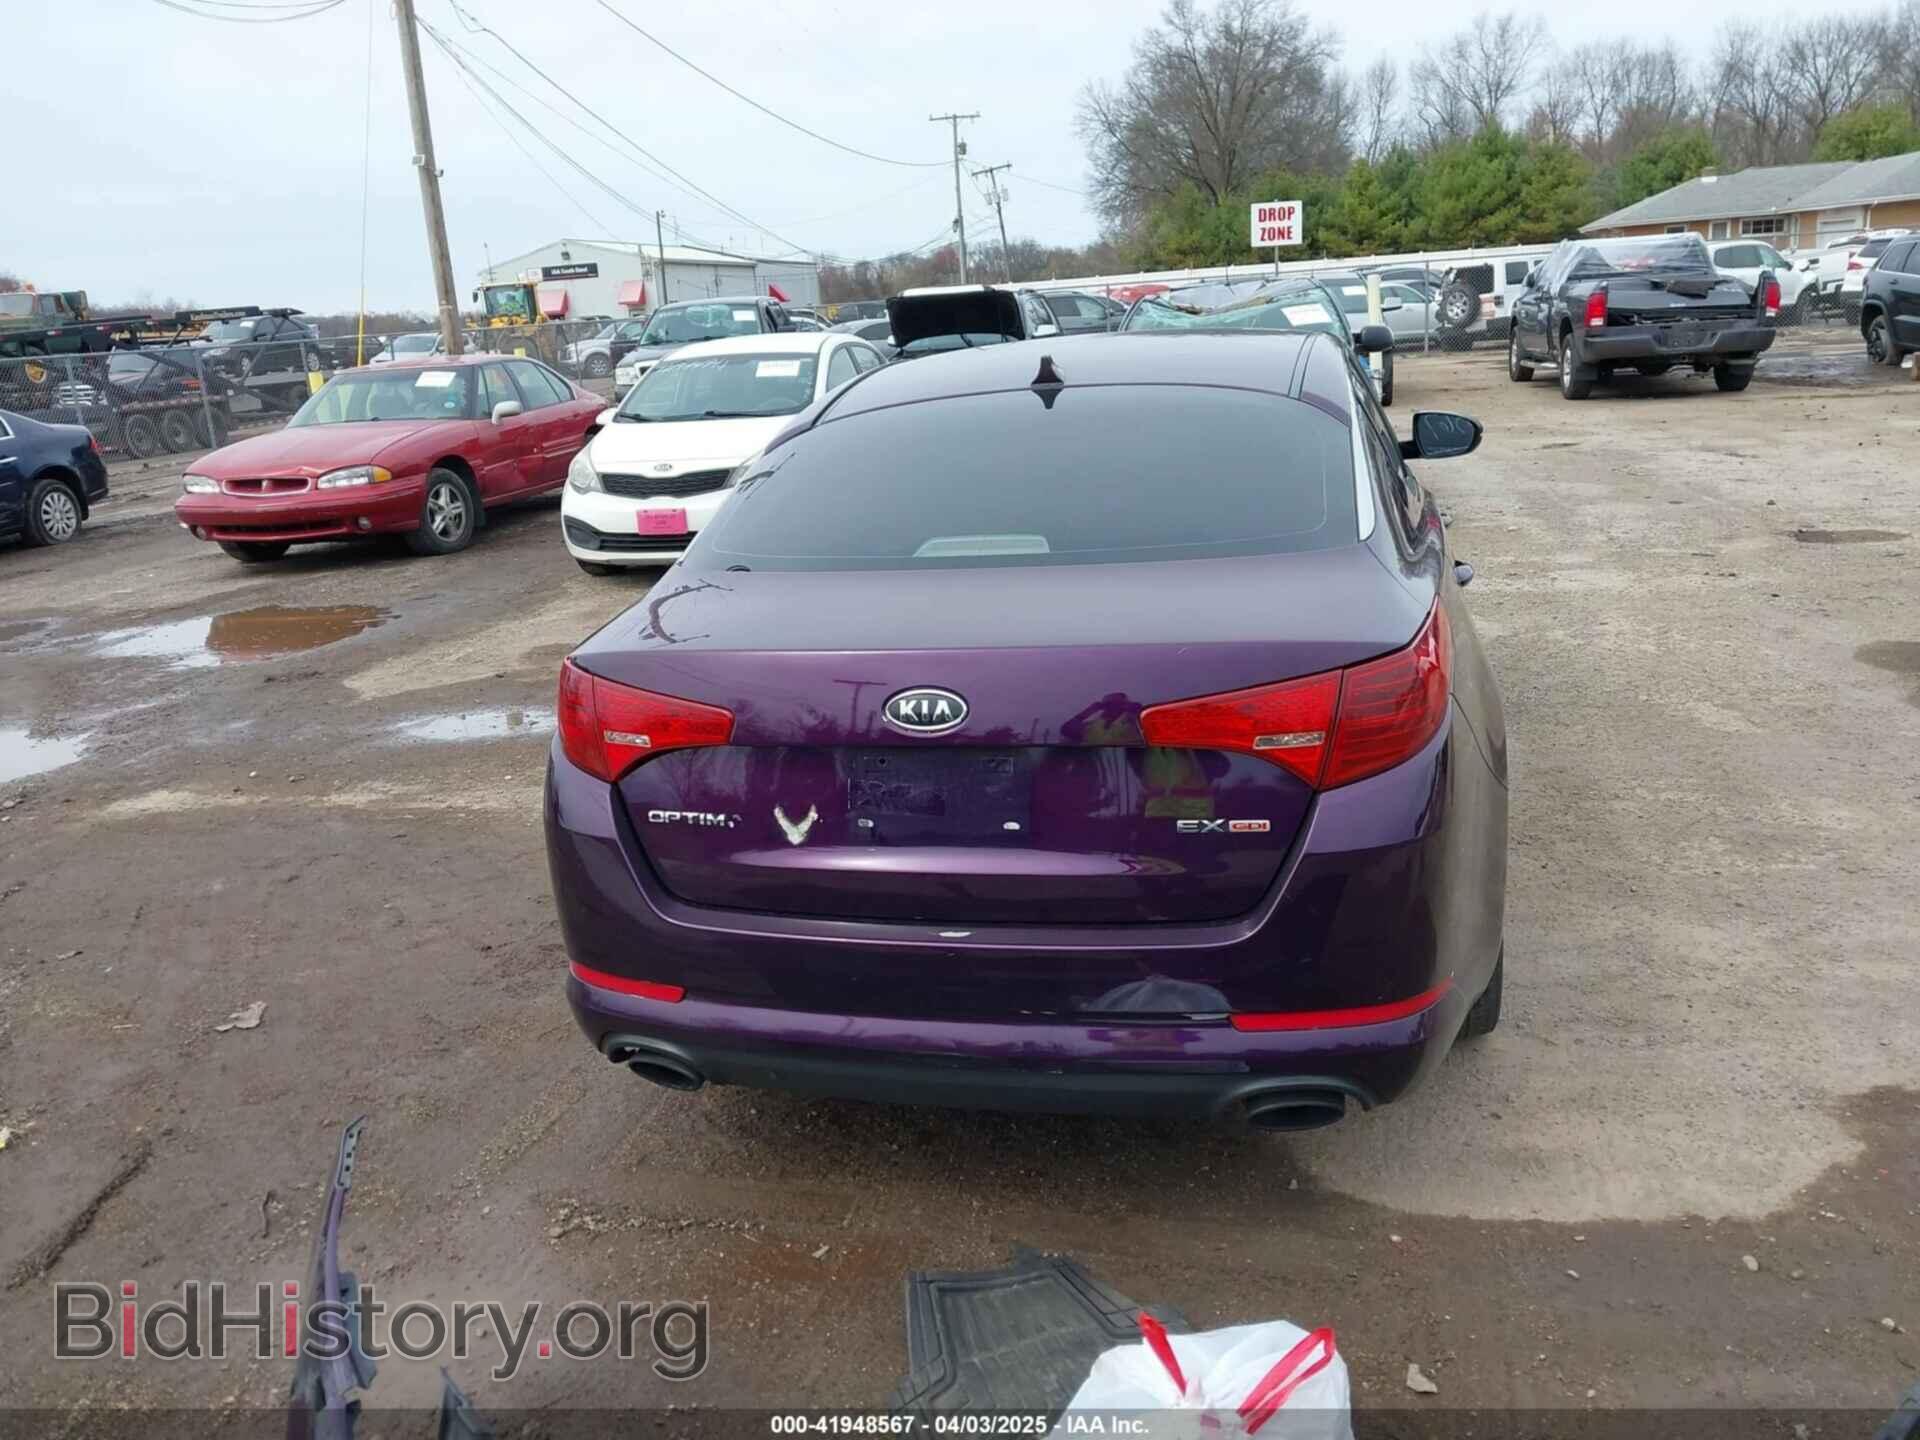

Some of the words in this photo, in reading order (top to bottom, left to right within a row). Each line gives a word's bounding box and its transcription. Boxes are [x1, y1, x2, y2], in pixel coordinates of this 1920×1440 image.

[1258, 206, 1295, 223] DROP
[1260, 225, 1293, 242] ZONE
[898, 699, 954, 721] KIA
[1176, 818, 1226, 833] EX
[1231, 821, 1268, 831] GDI
